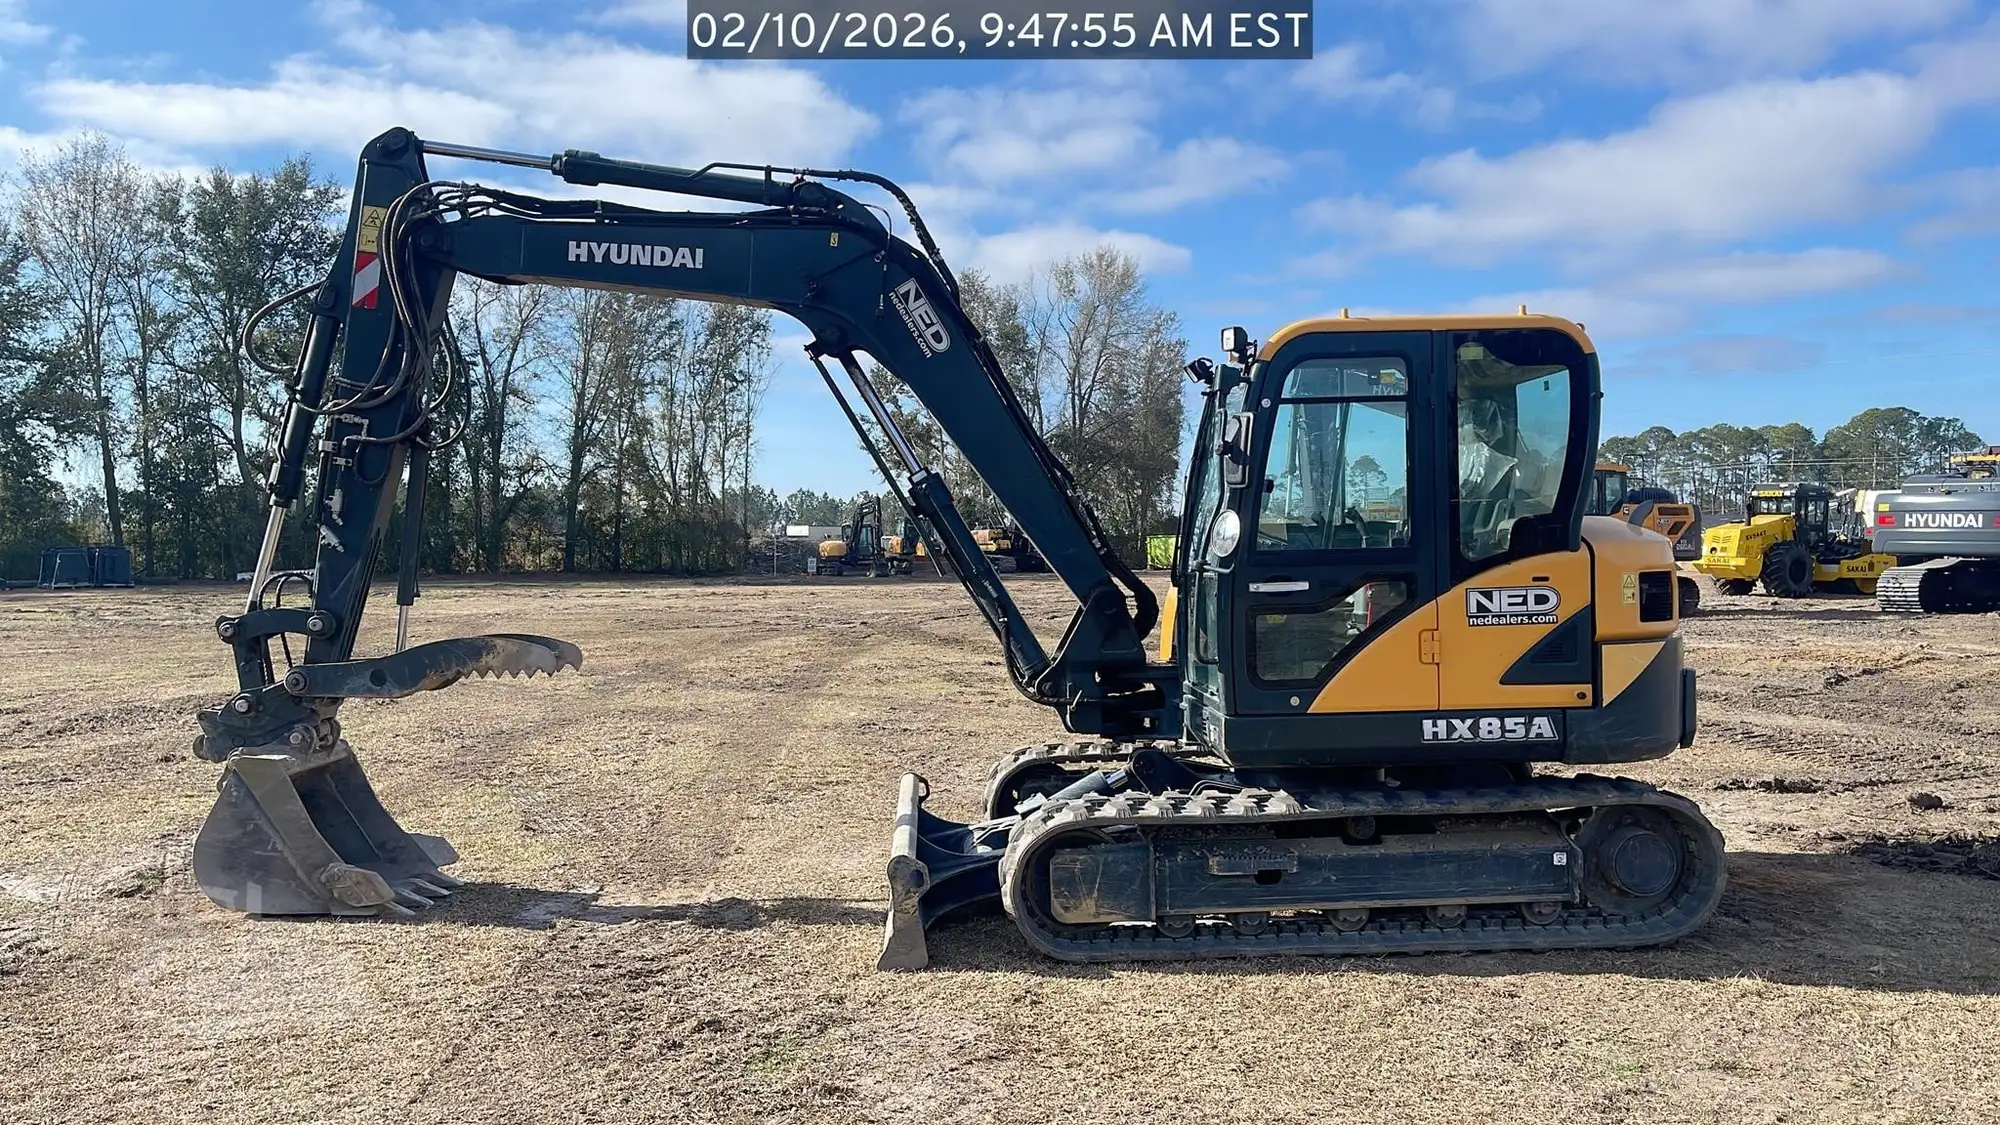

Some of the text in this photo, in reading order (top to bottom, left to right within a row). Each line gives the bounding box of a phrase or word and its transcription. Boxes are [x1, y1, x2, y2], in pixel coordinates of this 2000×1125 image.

[568, 240, 704, 269] HYUNDAI
[889, 291, 933, 358] nedealers.com
[897, 279, 949, 352] NED
[1904, 513, 1984, 528] HYUNDAI
[1707, 556, 1731, 564] SAKAI
[1846, 565, 1867, 573] SAKAI
[1468, 589, 1559, 613] NED
[1469, 614, 1557, 626] nedealers.com
[1421, 716, 1557, 741] HX85A
